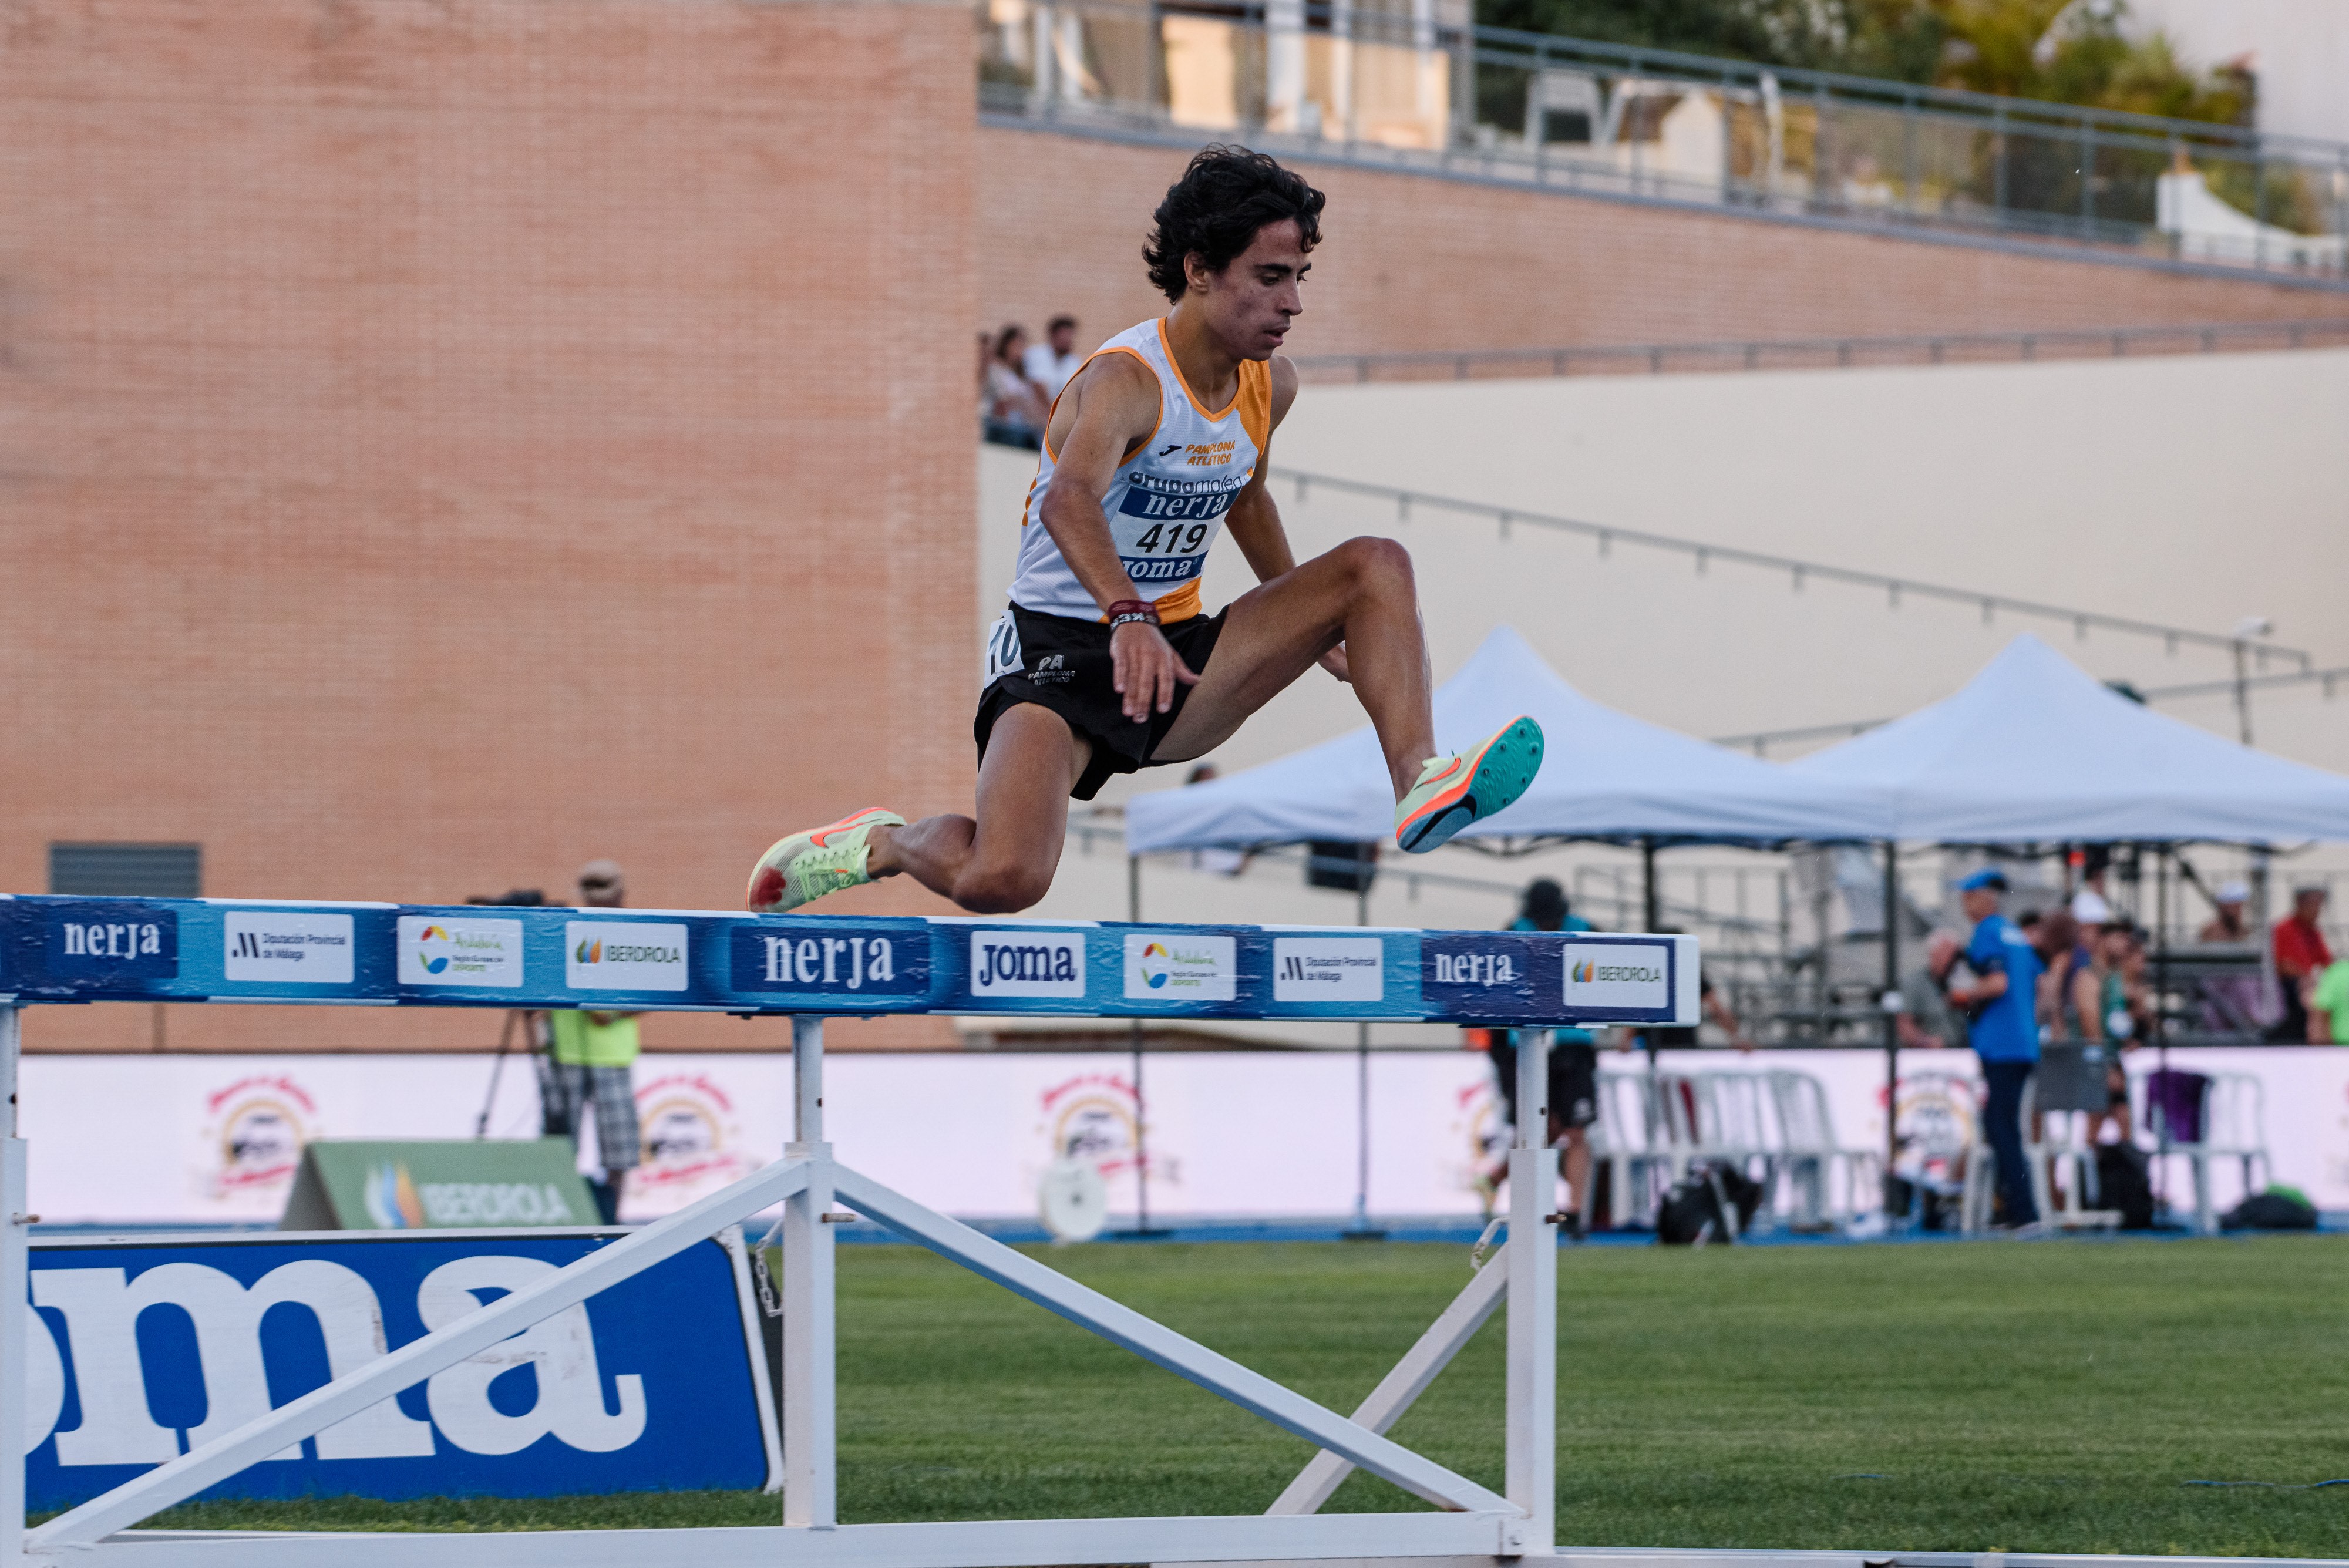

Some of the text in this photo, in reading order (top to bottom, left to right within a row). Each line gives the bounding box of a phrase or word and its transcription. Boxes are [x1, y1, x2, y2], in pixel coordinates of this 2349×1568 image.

[1185, 440, 1236, 455] PAMPLONA
[1142, 494, 1229, 518] nerja
[1135, 523, 1208, 553] 419
[1038, 654, 1064, 671] PA
[63, 923, 161, 960] nerja
[604, 945, 683, 964] IBERDROLA
[763, 936, 896, 990] nerja
[1435, 953, 1519, 987] nerja
[1597, 964, 1661, 982] IBERDROLA
